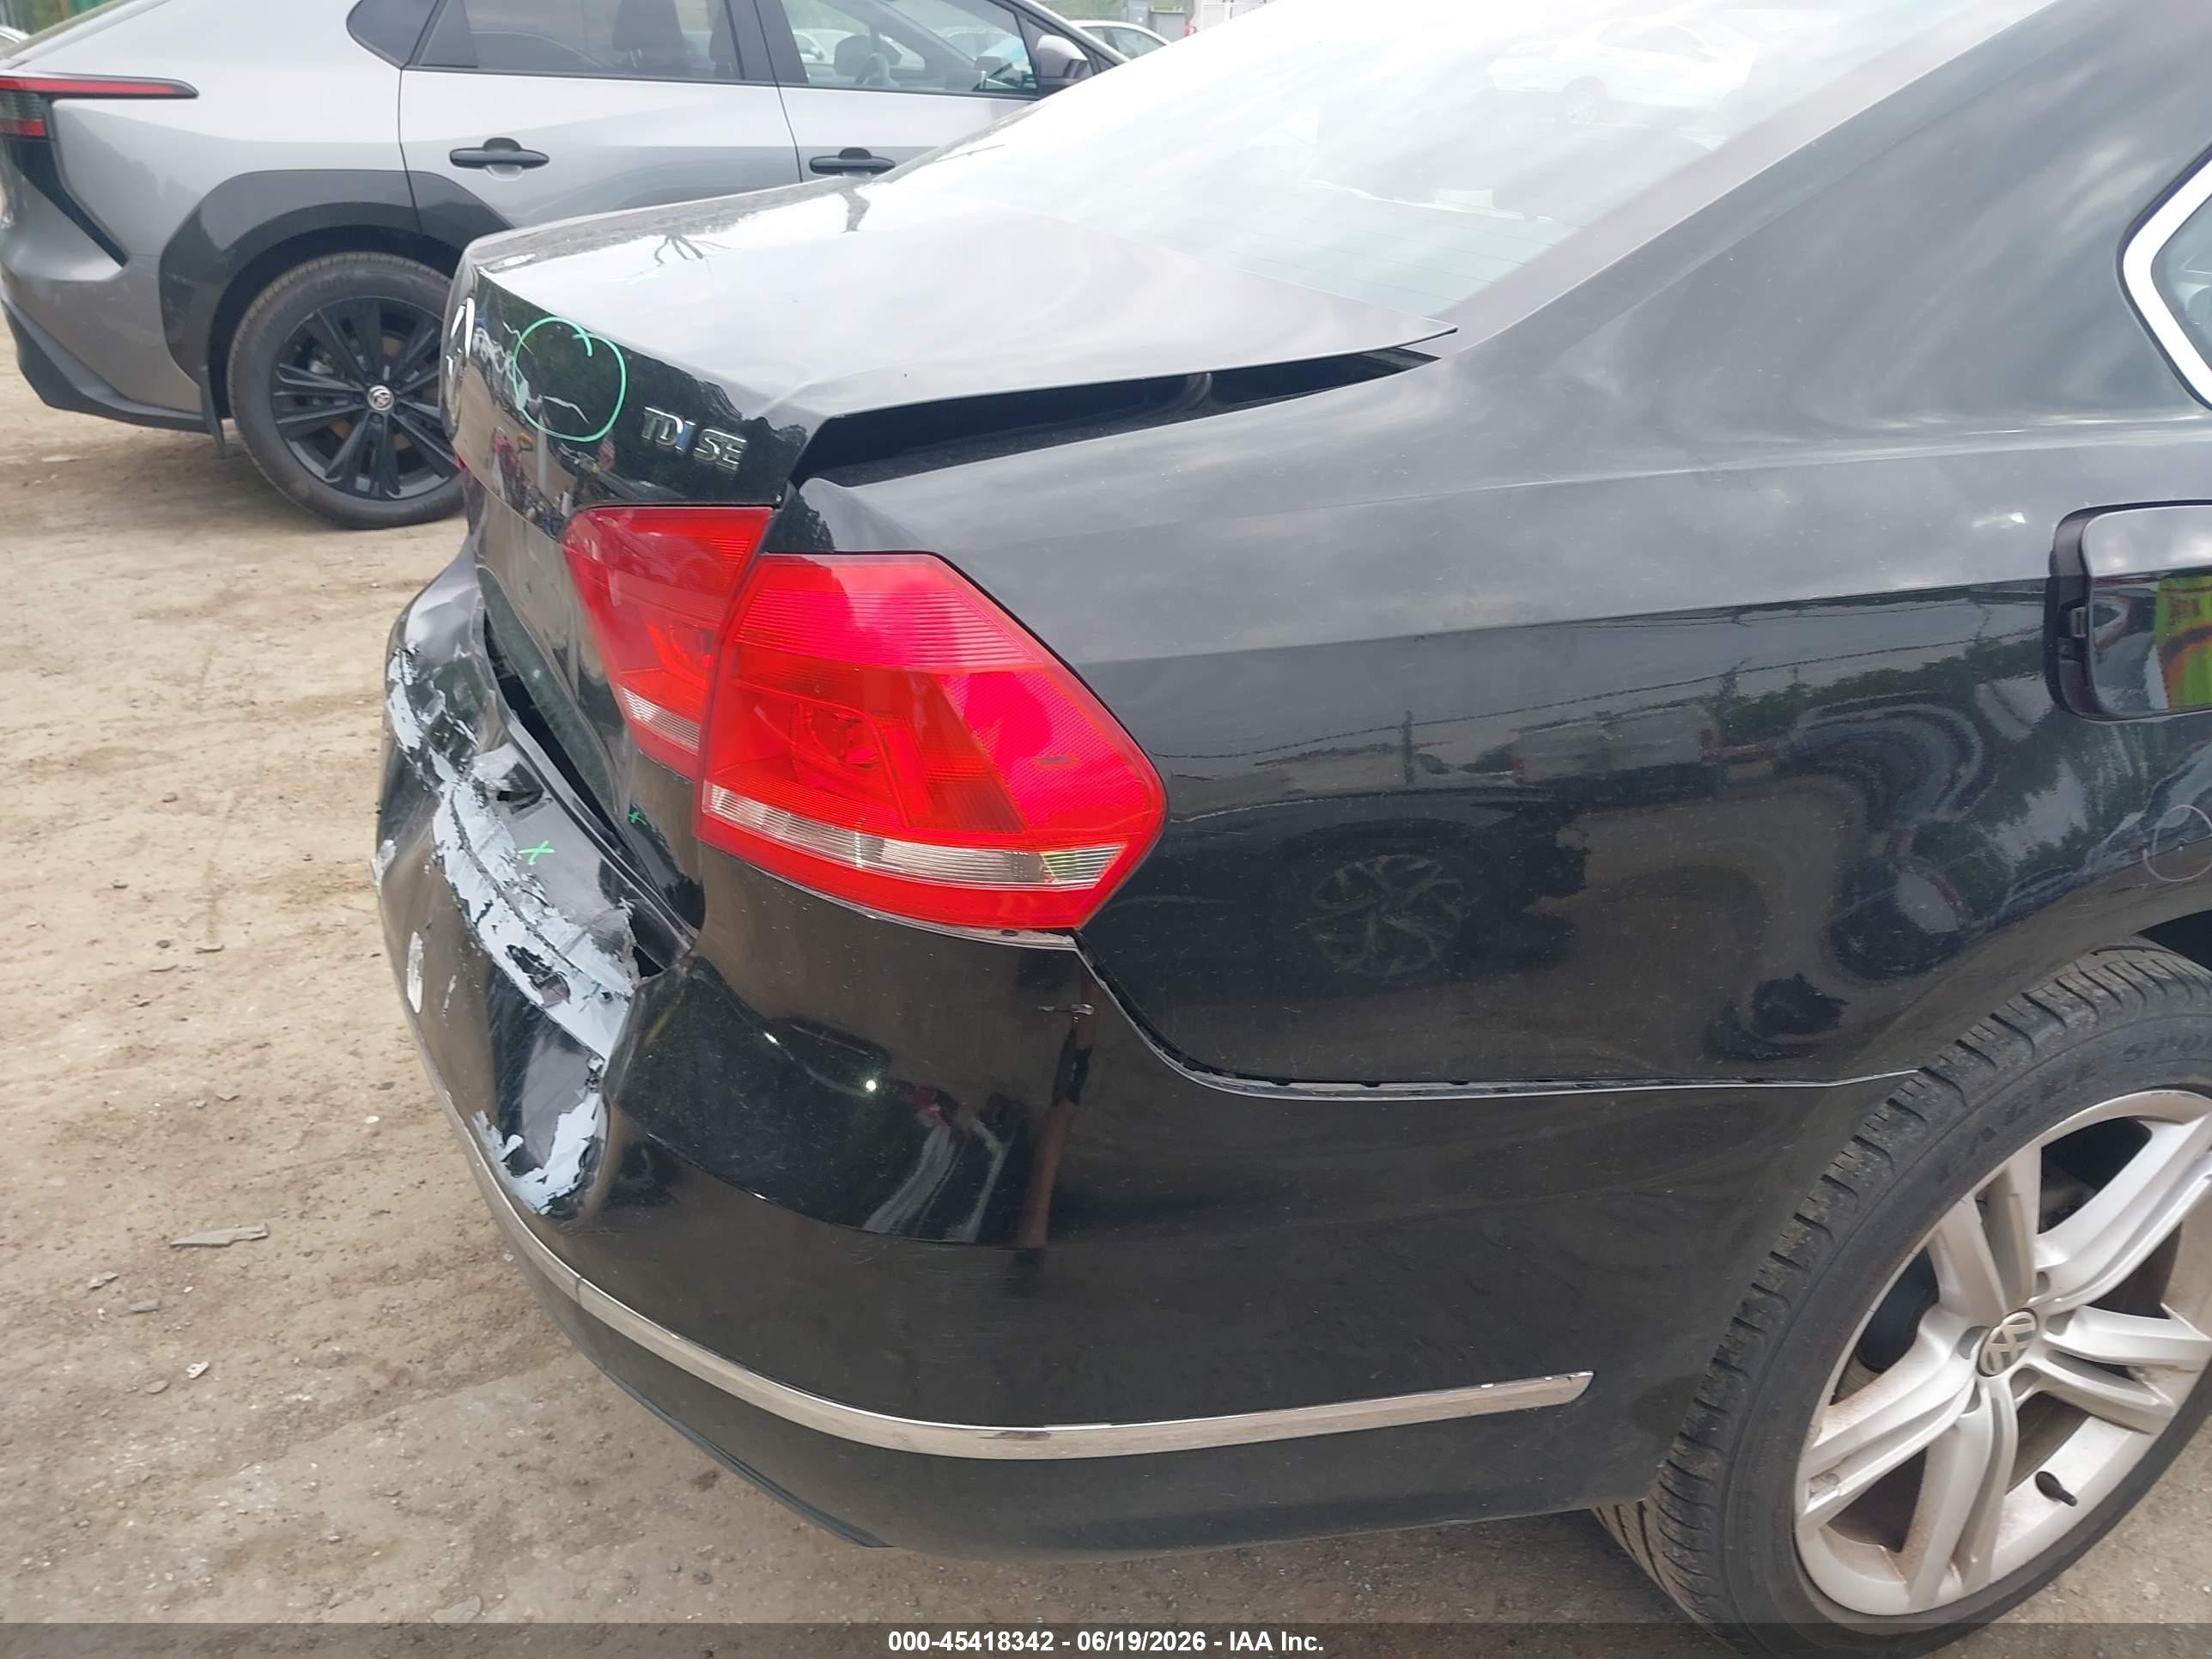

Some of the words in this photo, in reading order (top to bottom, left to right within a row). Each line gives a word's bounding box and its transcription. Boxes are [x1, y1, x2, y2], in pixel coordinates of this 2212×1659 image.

[641, 406, 696, 453] TDI
[693, 428, 749, 472] SE
[2122, 1033, 2212, 1063] SPO
